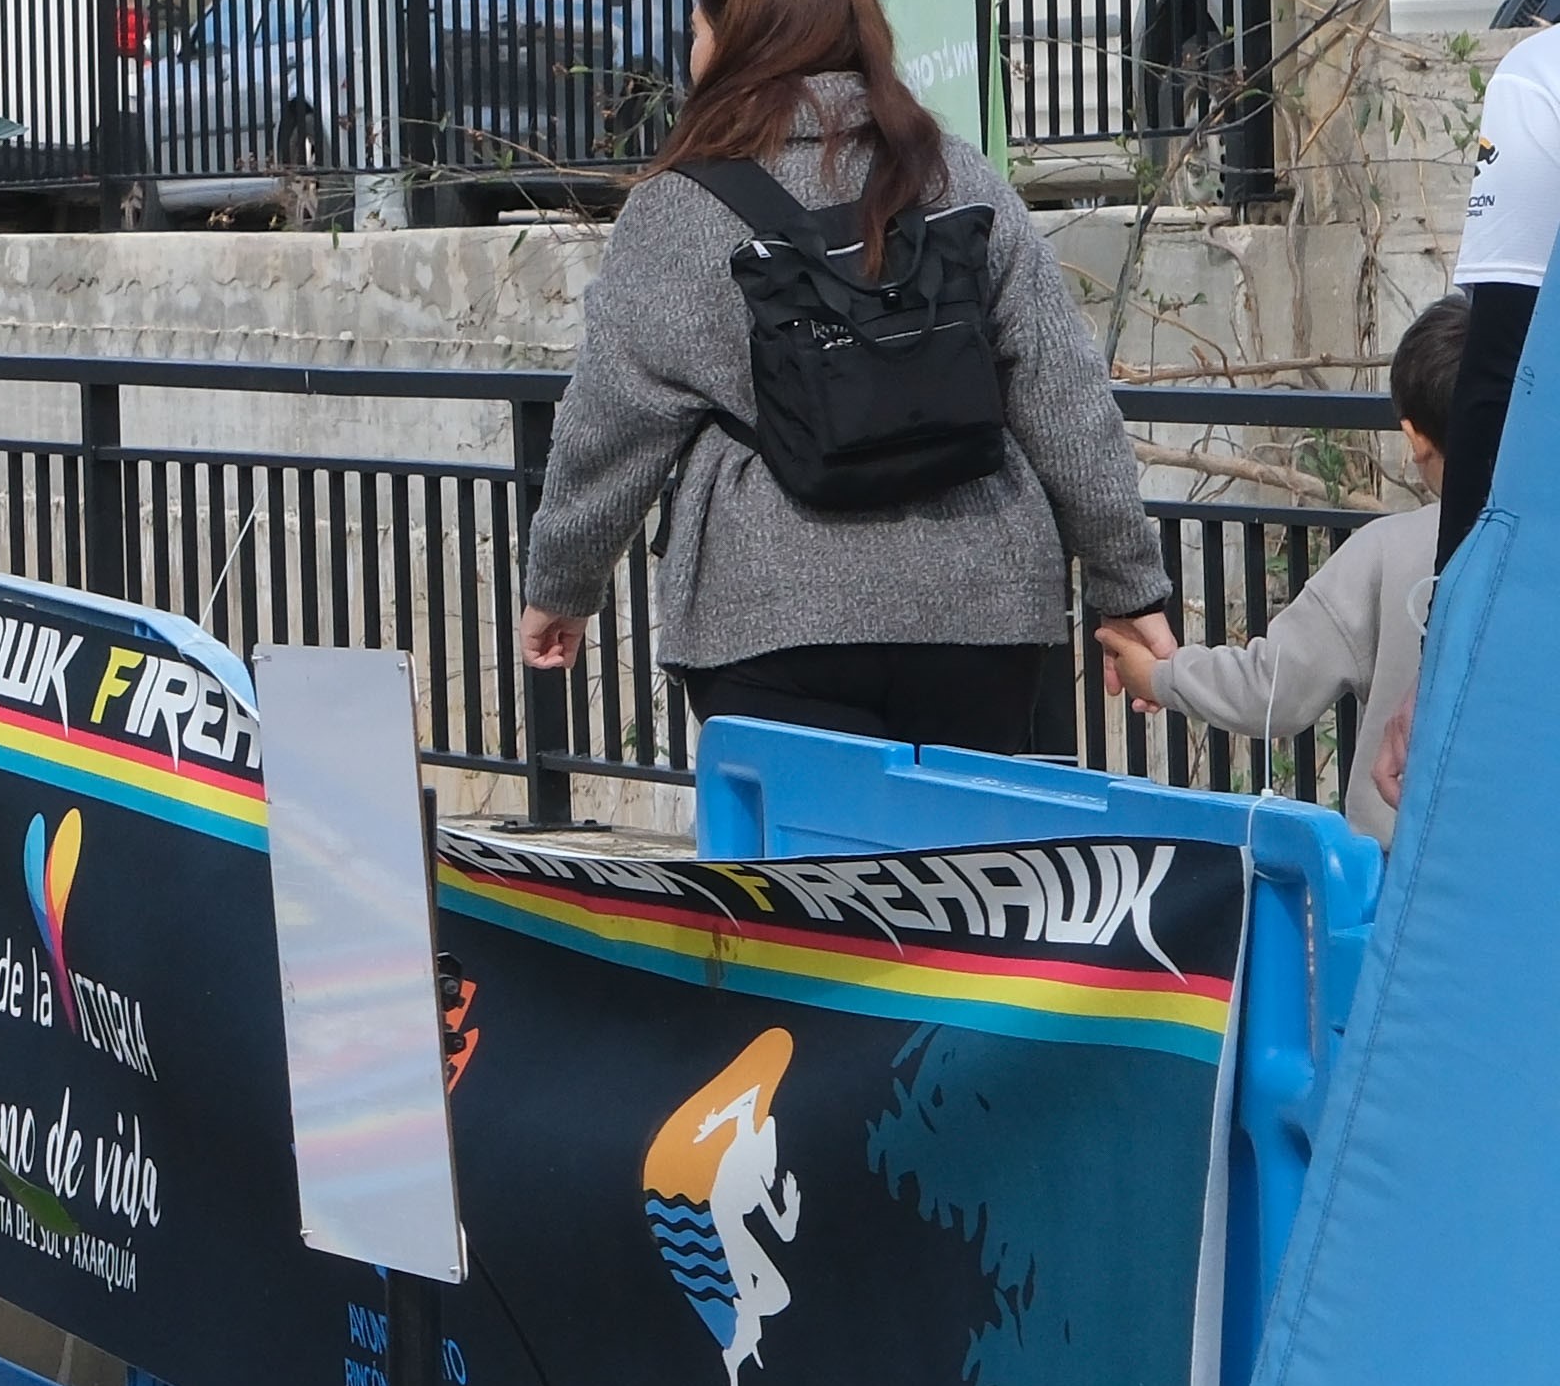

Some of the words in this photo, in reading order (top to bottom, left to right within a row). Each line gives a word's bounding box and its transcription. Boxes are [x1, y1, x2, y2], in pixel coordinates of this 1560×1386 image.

[718, 843, 1188, 983] FIREHAWK
[32, 948, 53, 1028] la
[46, 1086, 85, 1198] de
[97, 1112, 161, 1228] vida
[16, 1204, 37, 1249] DEL
[73, 1231, 137, 1293] AXARQUÍA
